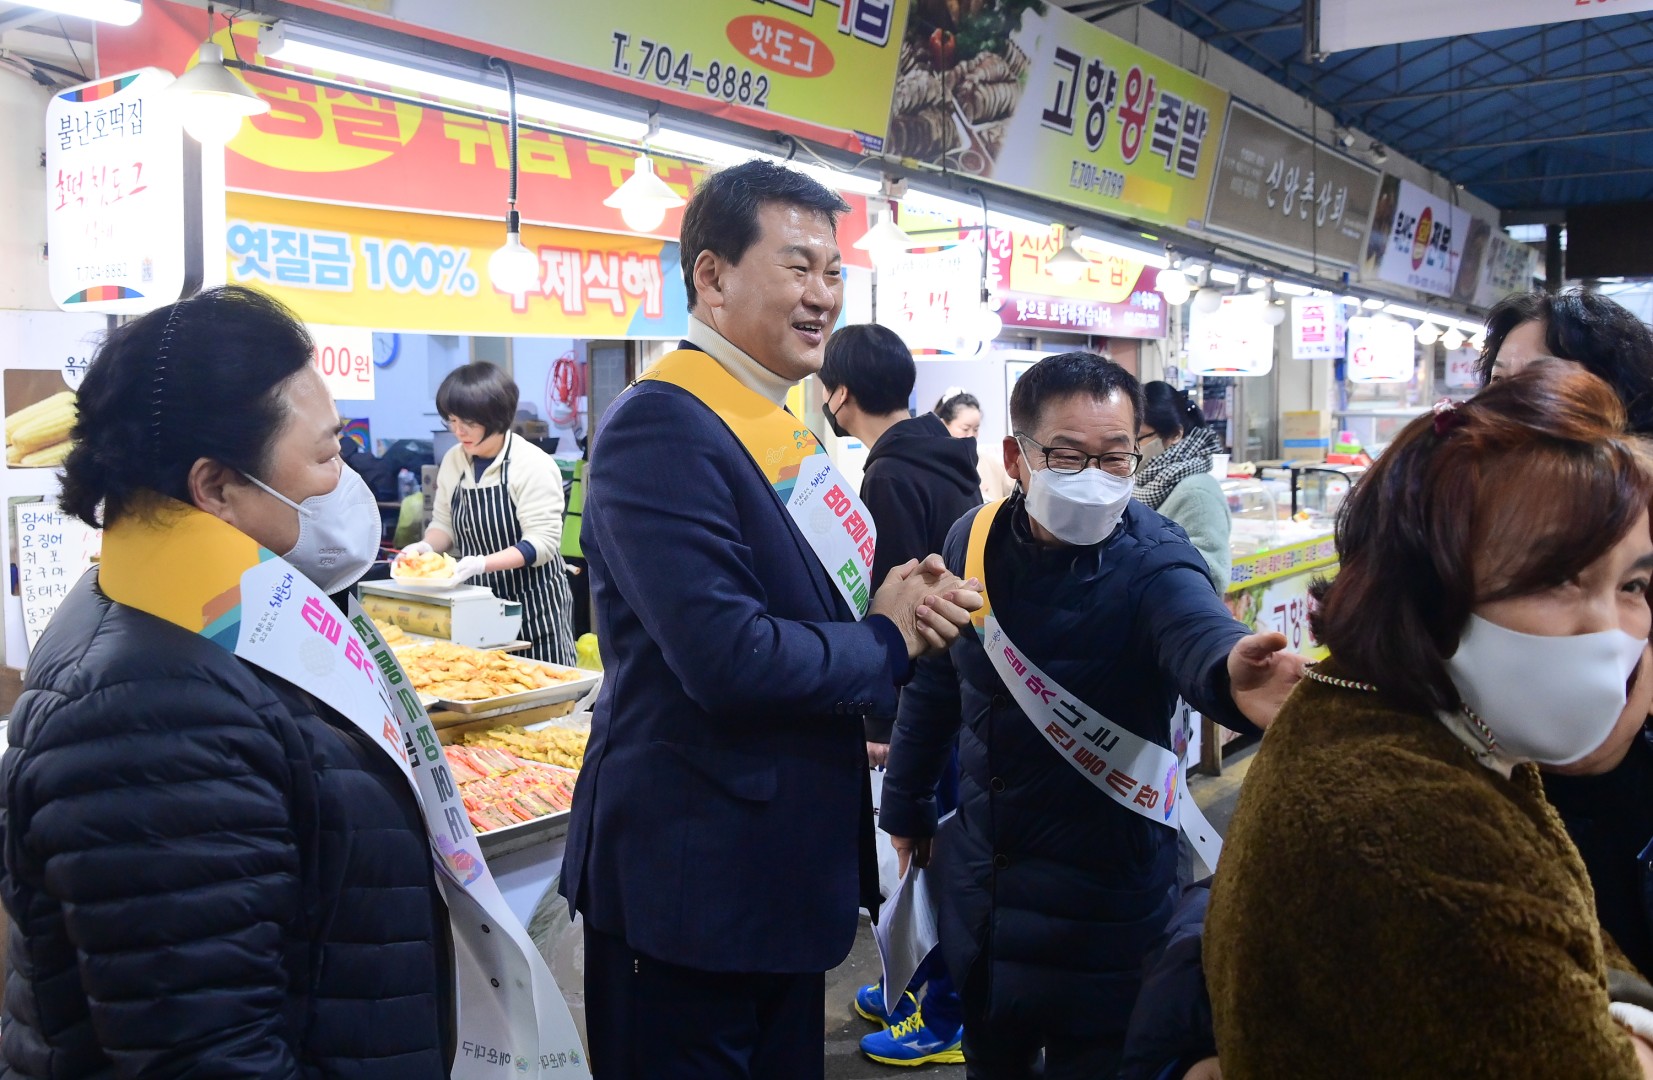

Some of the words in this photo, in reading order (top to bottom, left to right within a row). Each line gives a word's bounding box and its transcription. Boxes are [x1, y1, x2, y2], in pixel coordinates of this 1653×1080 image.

[749, 20, 816, 73] 핫도그
[57, 98, 143, 152] 불난호떡집
[1042, 46, 1209, 179] 고향왕족발
[226, 222, 351, 288] 엿질금
[363, 241, 477, 294] 100%
[64, 356, 90, 377] 옥수
[21, 510, 63, 532] 왕새우
[823, 484, 877, 573] 명절장
[1273, 590, 1318, 649] 고향
[1044, 720, 1160, 810] 전통시장
